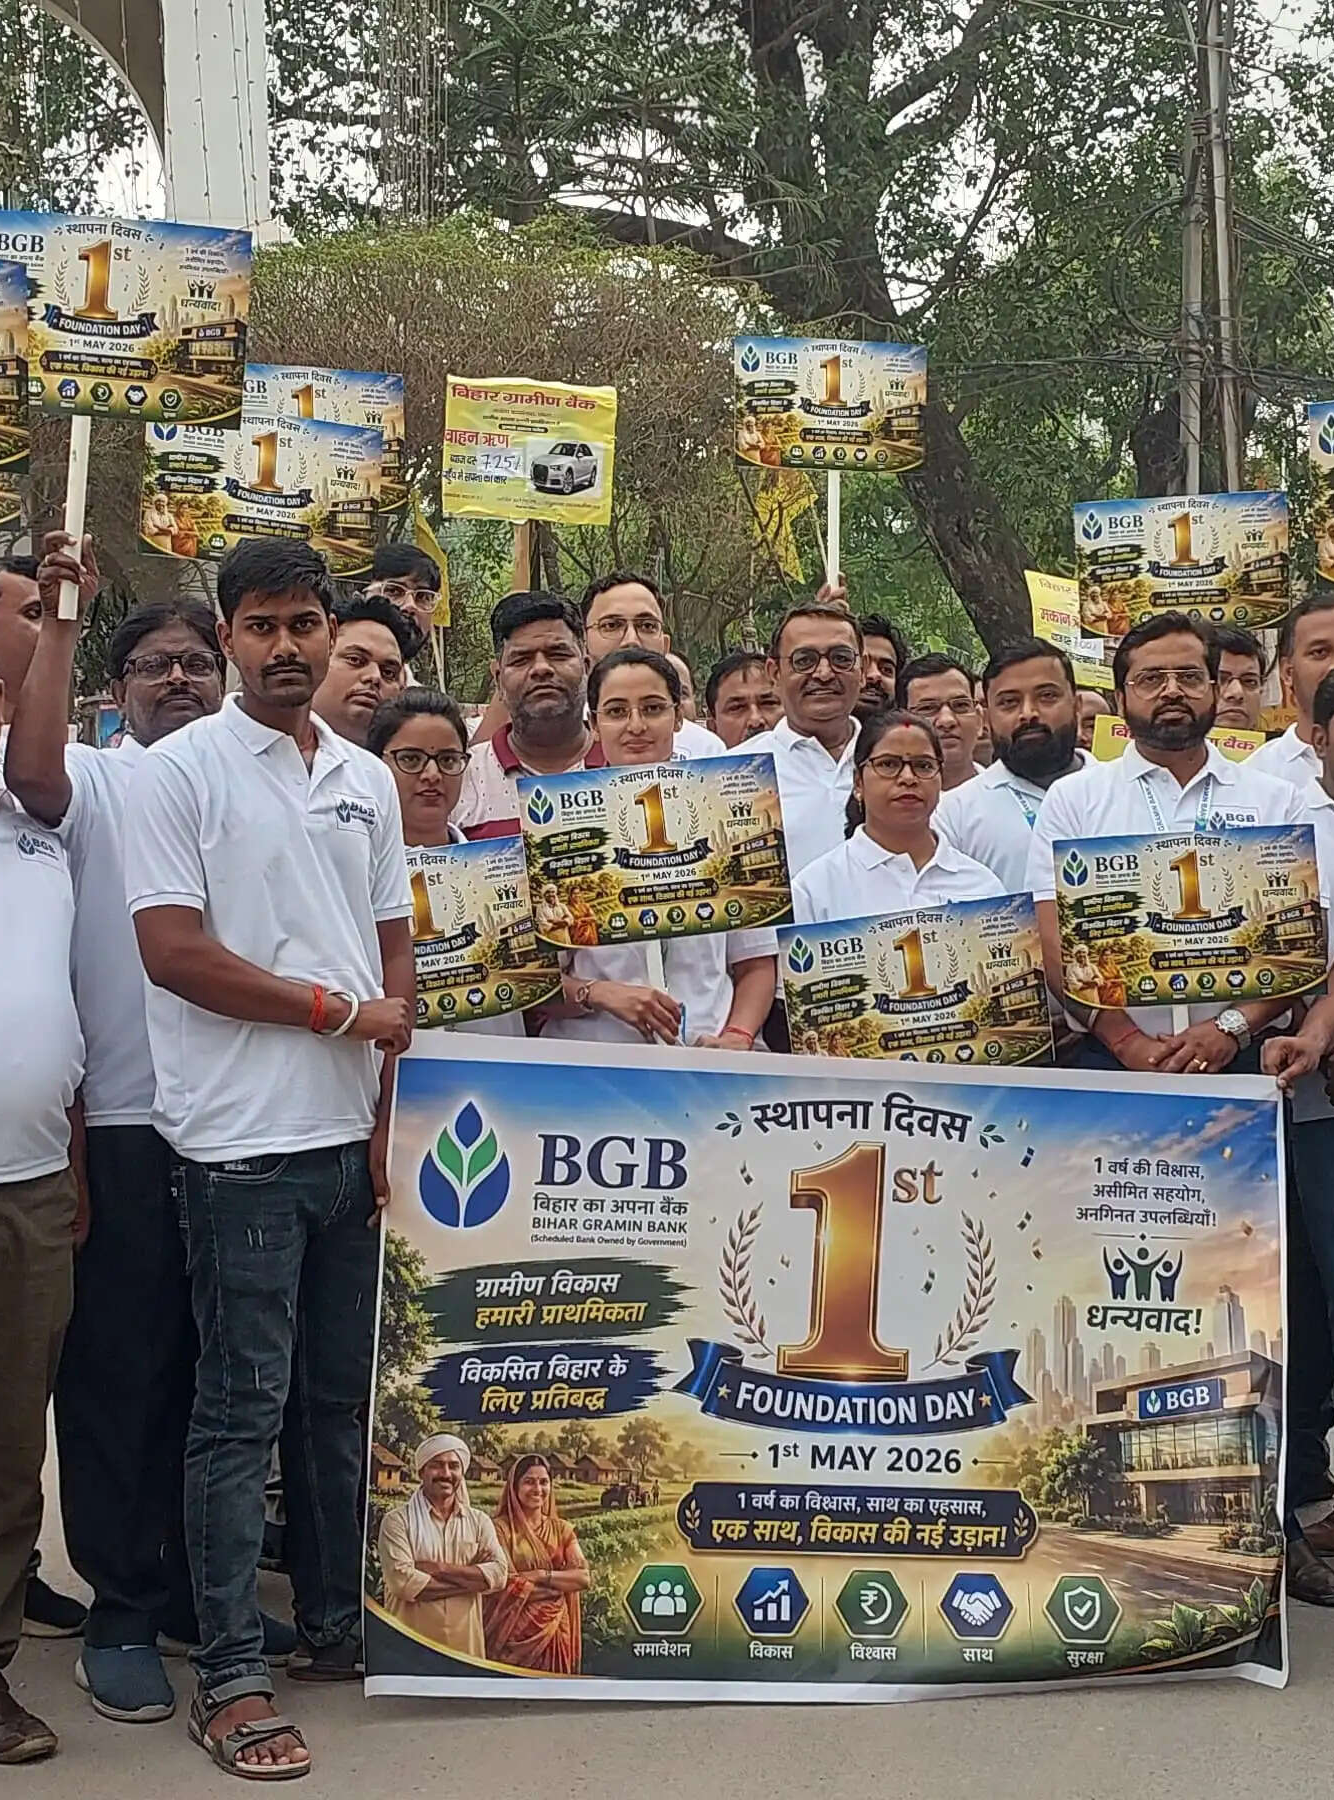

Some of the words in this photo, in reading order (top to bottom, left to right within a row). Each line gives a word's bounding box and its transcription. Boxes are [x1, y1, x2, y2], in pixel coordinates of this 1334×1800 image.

[65, 222, 107, 236] स्थापना
[111, 222, 142, 241] दिवस
[58, 318, 121, 336] FOUNDATION
[122, 322, 142, 335] DAY
[82, 338, 106, 350] MAY
[108, 340, 135, 353] 2026
[450, 384, 500, 402] बिहार
[502, 391, 562, 407] ग्रामीण
[444, 430, 480, 446] वाहन
[481, 432, 510, 448] ऋण
[617, 769, 655, 786] स्थापना
[657, 766, 684, 780] दिवस
[559, 789, 604, 809] BGB
[1225, 812, 1255, 823] BGB
[629, 853, 683, 867] FOUNDATION
[683, 851, 700, 864] DAY
[1094, 854, 1140, 873] BGB
[652, 870, 673, 880] MAY
[674, 868, 697, 878] 2026
[819, 937, 864, 957] BGB
[889, 996, 942, 1012] FOUNDATION
[942, 994, 959, 1007] DAY
[750, 1100, 873, 1134] स्थापना
[882, 1092, 973, 1143] दिवस
[534, 1133, 689, 1190] BGB
[1093, 1157, 1103, 1174] 1
[1108, 1157, 1129, 1177] वर्ष
[1132, 1157, 1151, 1177] की
[1156, 1159, 1205, 1180] विश्वास,
[1092, 1181, 1148, 1200] असीमित
[1153, 1184, 1205, 1204] सहयोग,
[533, 1192, 578, 1214] बिहार
[583, 1198, 606, 1214] का
[610, 1199, 655, 1216] अपना
[659, 1195, 689, 1217] बैंक
[531, 1216, 578, 1231] BIHAR
[582, 1218, 643, 1233] GRAMIN
[647, 1220, 688, 1234] BANK
[1075, 1206, 1135, 1223] अनगिनत
[1139, 1207, 1217, 1228] उपलब्धियाँ!
[530, 1233, 574, 1245] (Scheduled
[576, 1234, 596, 1244] Bank
[598, 1235, 625, 1246] Owned
[626, 1236, 637, 1247] by
[638, 1237, 688, 1249] Government)
[475, 1270, 545, 1298] ग्रामीण
[550, 1268, 621, 1296] विकास
[475, 1299, 536, 1330] हमारी
[540, 1296, 648, 1325] प्राथमिकता
[1087, 1304, 1203, 1337] धन्यवाद!
[459, 1355, 543, 1384] विकसित
[547, 1353, 604, 1381] बिहार
[608, 1353, 629, 1378] के
[480, 1385, 526, 1415] लिए
[530, 1384, 609, 1413] प्रतिबद्ध
[735, 1380, 917, 1425] FOUNDATION
[925, 1387, 977, 1424] DAY
[1166, 1385, 1211, 1410] BGB
[767, 1441, 800, 1469] 1st
[810, 1446, 878, 1472] MAY
[886, 1448, 962, 1474] 2026
[737, 1492, 746, 1509] 1
[751, 1491, 776, 1510] वर्ष
[779, 1493, 800, 1510] का
[804, 1491, 861, 1514] विश्वास,
[866, 1497, 901, 1513] साथ
[903, 1498, 925, 1514] का
[928, 1499, 987, 1519] एहसास,
[711, 1519, 749, 1544] एक
[752, 1519, 803, 1547] साथ,
[810, 1516, 878, 1546] विकास
[883, 1518, 912, 1546] की
[915, 1518, 945, 1550] नई
[949, 1525, 1007, 1552] उड़ान!
[633, 1640, 692, 1658] समावेशन
[749, 1641, 794, 1660] विकास
[850, 1642, 898, 1662] विश्वास
[962, 1648, 994, 1663] साथ
[1067, 1649, 1105, 1668] सुरक्षा
